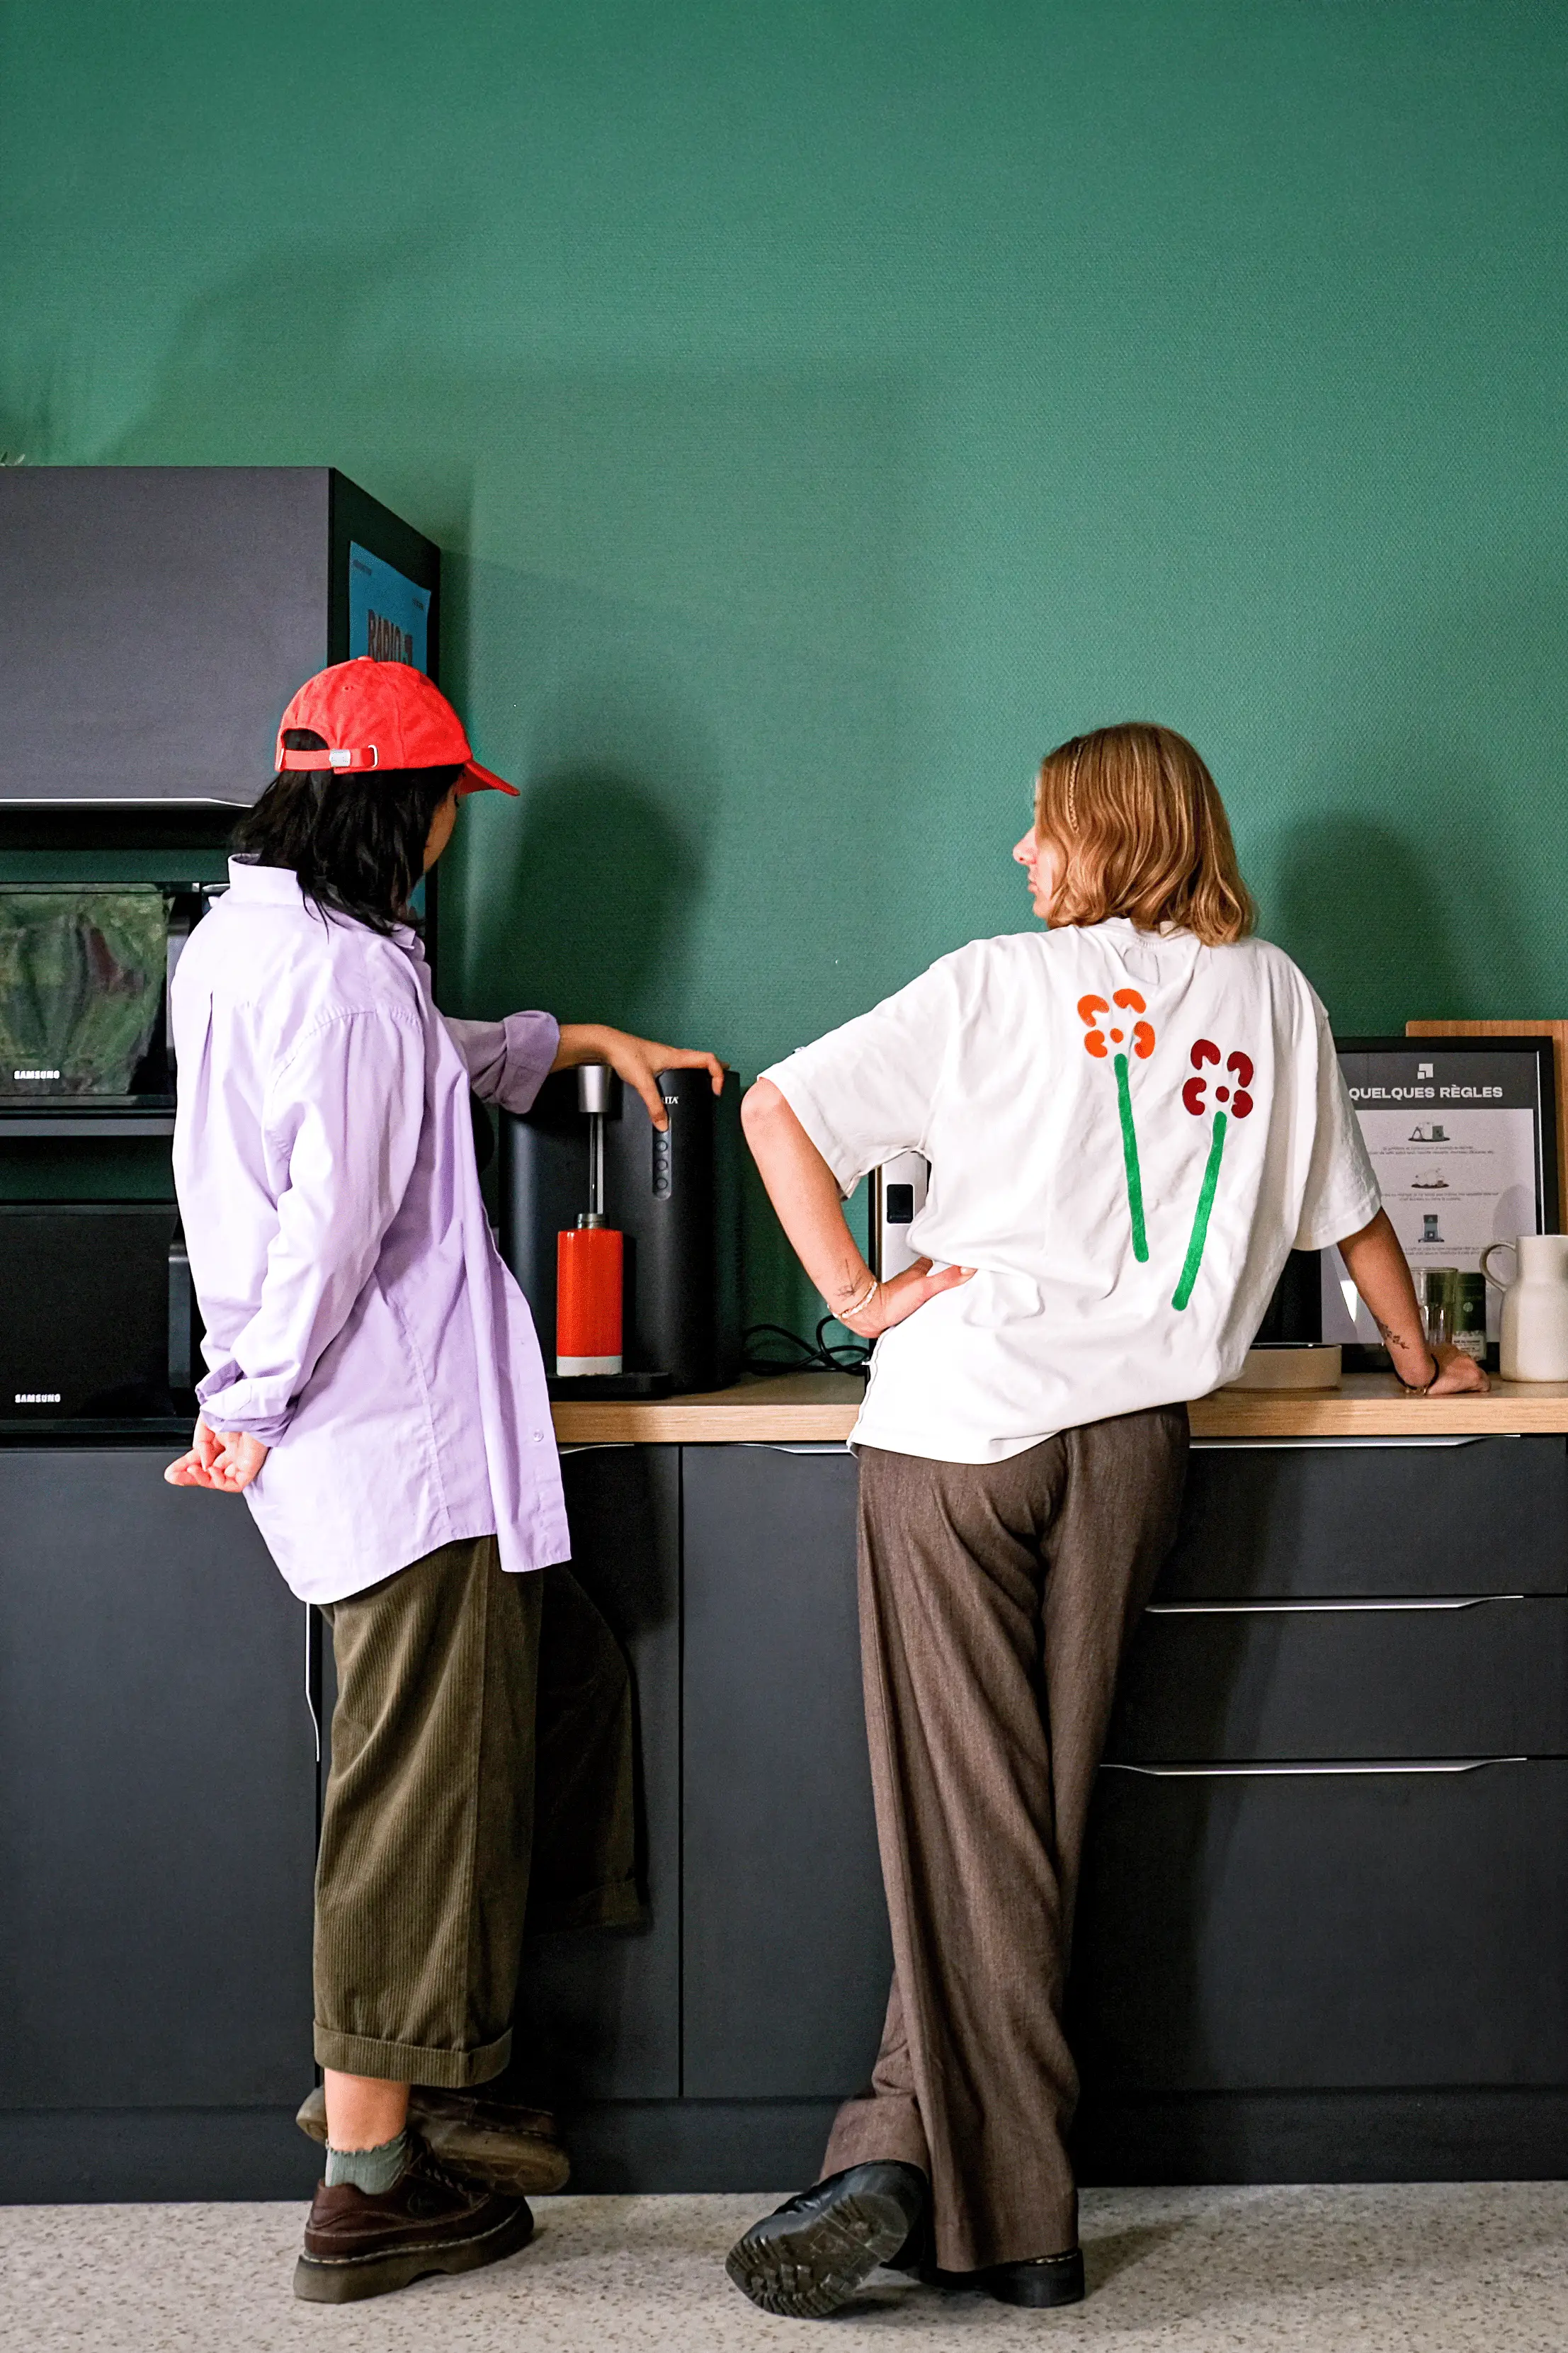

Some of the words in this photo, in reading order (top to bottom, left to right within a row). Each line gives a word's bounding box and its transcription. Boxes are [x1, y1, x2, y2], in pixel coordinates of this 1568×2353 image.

[14, 1070, 60, 1079] SAMSUNG
[1348, 1087, 1436, 1101] QUELQUES
[1440, 1084, 1503, 1098] RÈGLES
[15, 1393, 61, 1403] SAMSUNG
